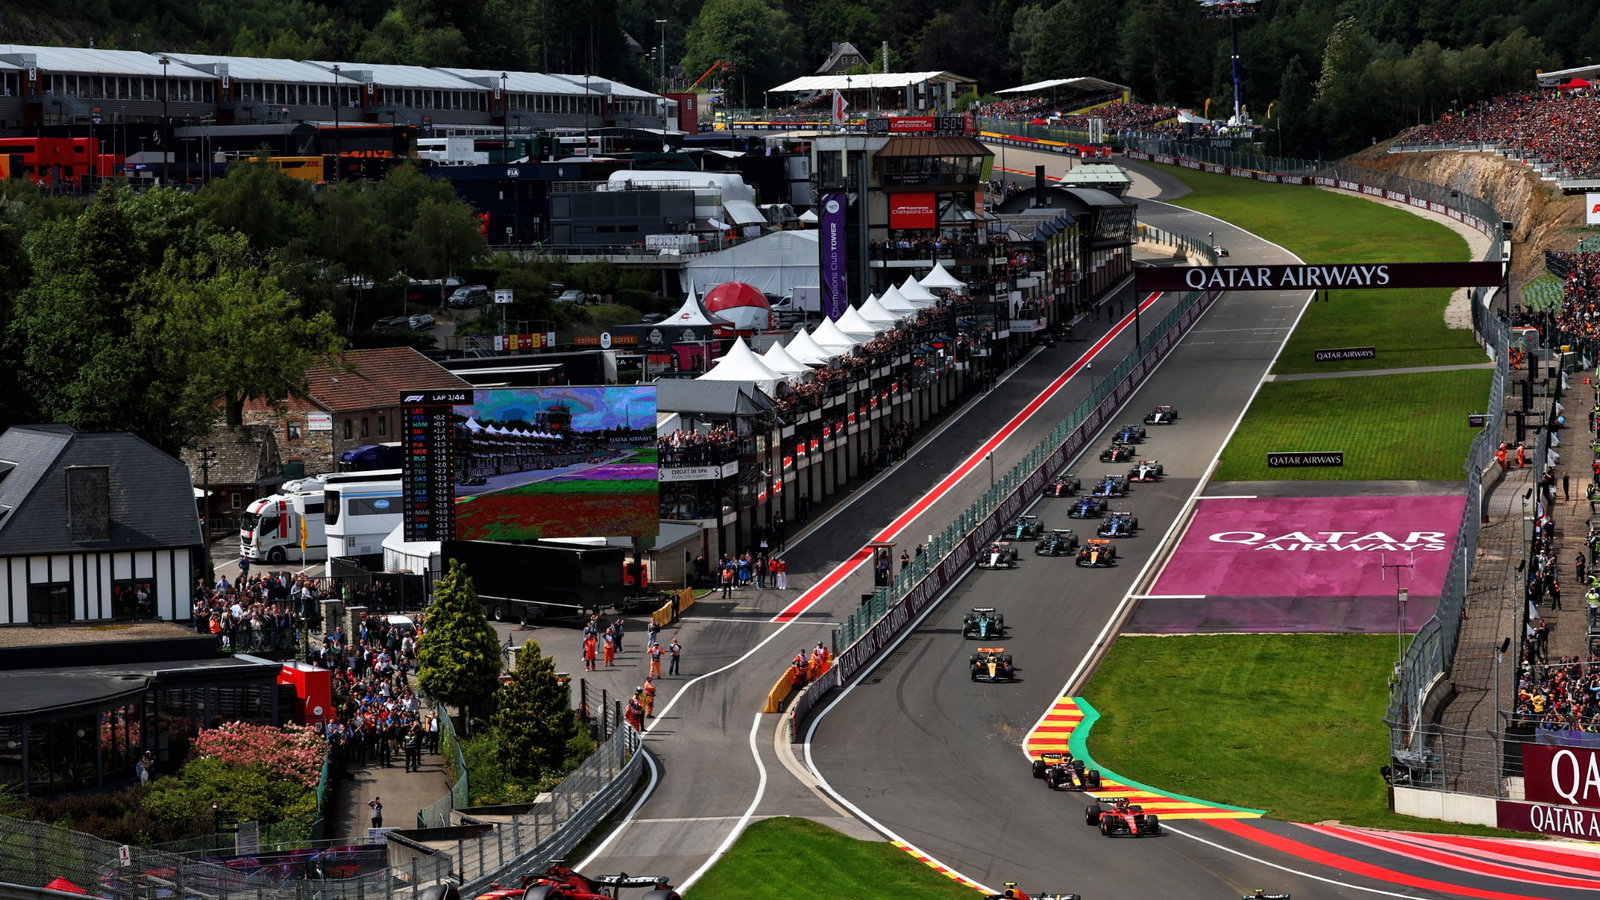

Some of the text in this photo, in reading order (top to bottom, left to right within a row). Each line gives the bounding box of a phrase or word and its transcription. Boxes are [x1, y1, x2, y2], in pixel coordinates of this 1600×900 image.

[30, 68, 36, 80] 3
[224, 77, 228, 88] 4
[940, 118, 963, 129] 15:04
[1186, 266, 1390, 290] QATAR AIRWAYS
[1316, 350, 1374, 360] QATAR AIRWAYS
[1270, 456, 1341, 466] QATAR AIRWAYS
[1208, 532, 1446, 544] QATAR
[876, 600, 908, 648] QATAR AIRWAYS
[840, 630, 876, 682] QATAR AIRWAYS
[1530, 805, 1585, 836] QATAR
